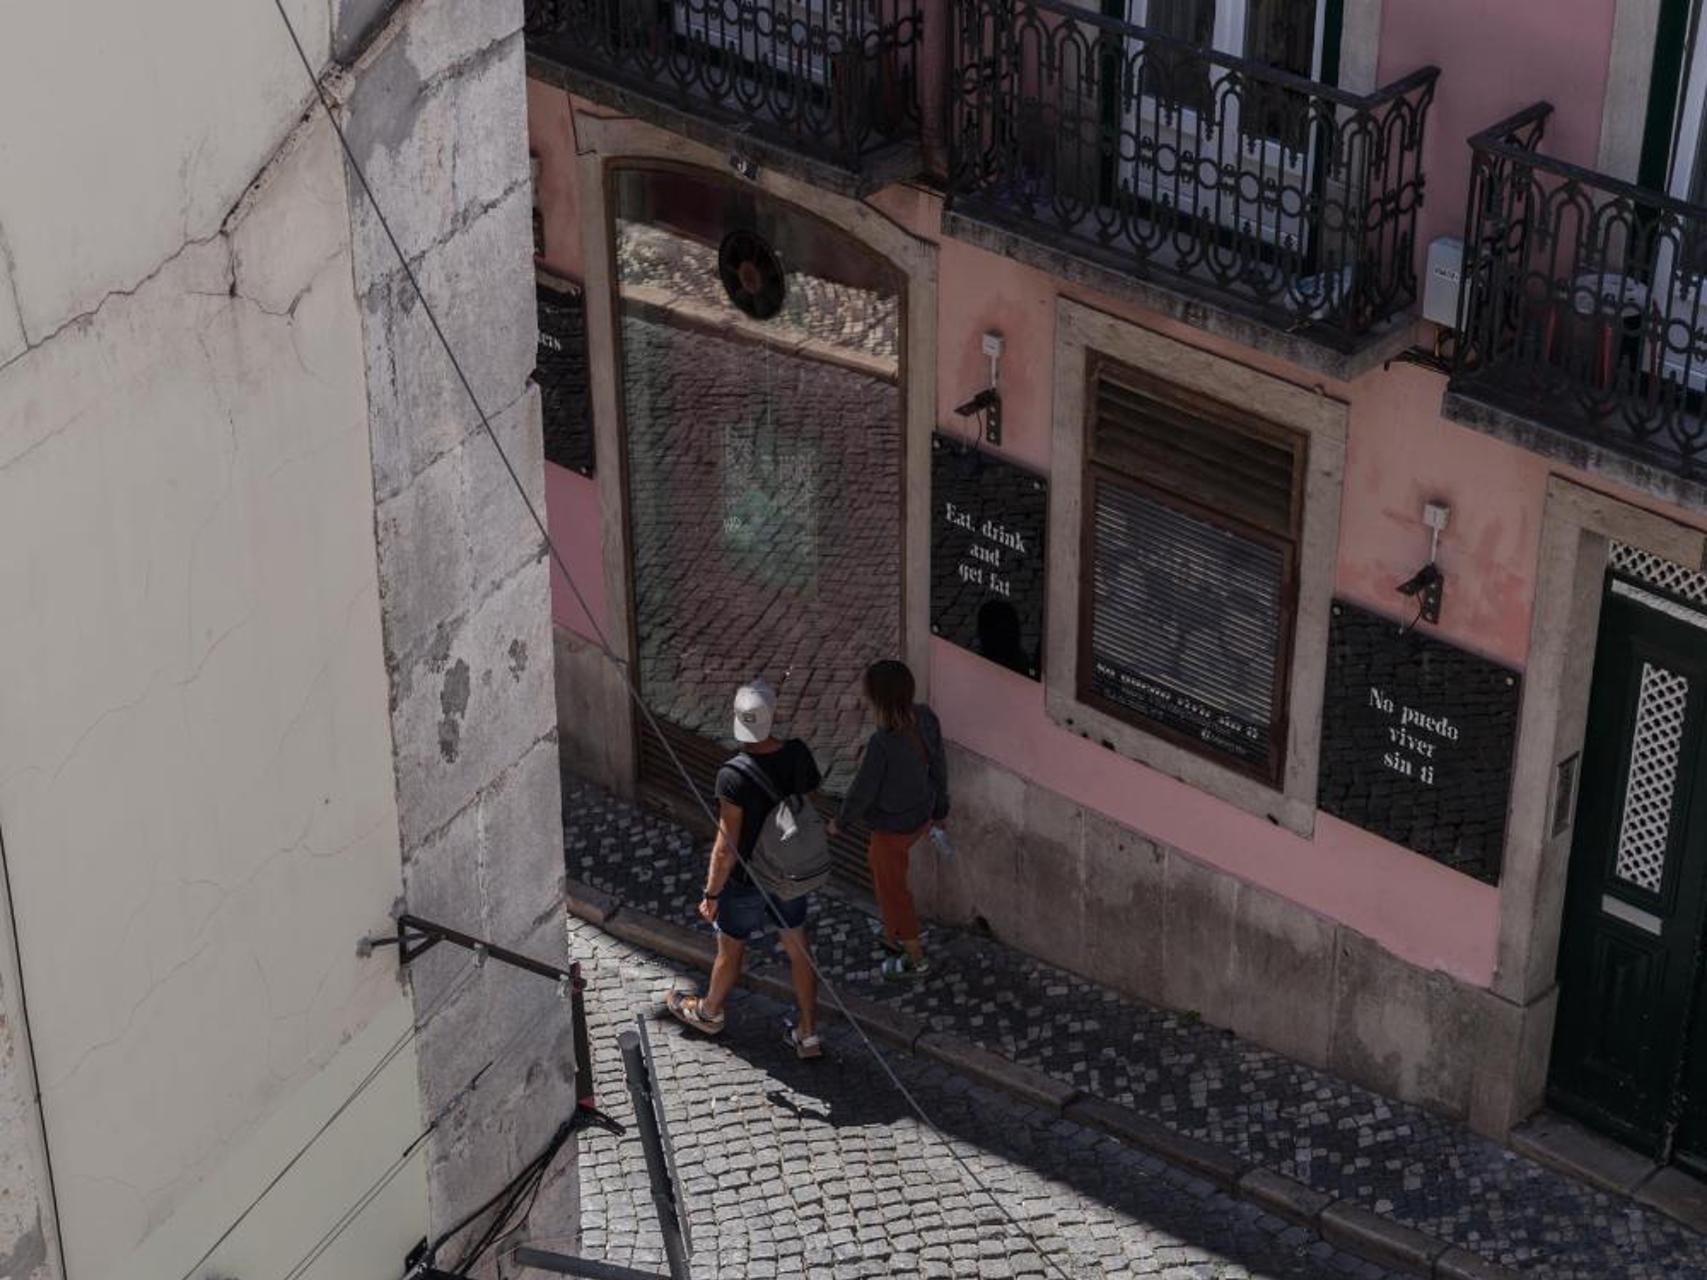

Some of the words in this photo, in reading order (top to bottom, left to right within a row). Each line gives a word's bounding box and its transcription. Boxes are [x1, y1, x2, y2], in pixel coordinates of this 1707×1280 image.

[982, 520, 1026, 553] drink
[969, 544, 1000, 567] and
[958, 563, 983, 584] get
[989, 573, 1011, 597] fat
[1369, 686, 1394, 713] No
[1400, 706, 1459, 740] puedo
[1388, 727, 1437, 758] viver
[1383, 751, 1412, 776] sin
[1419, 765, 1434, 785] ti
